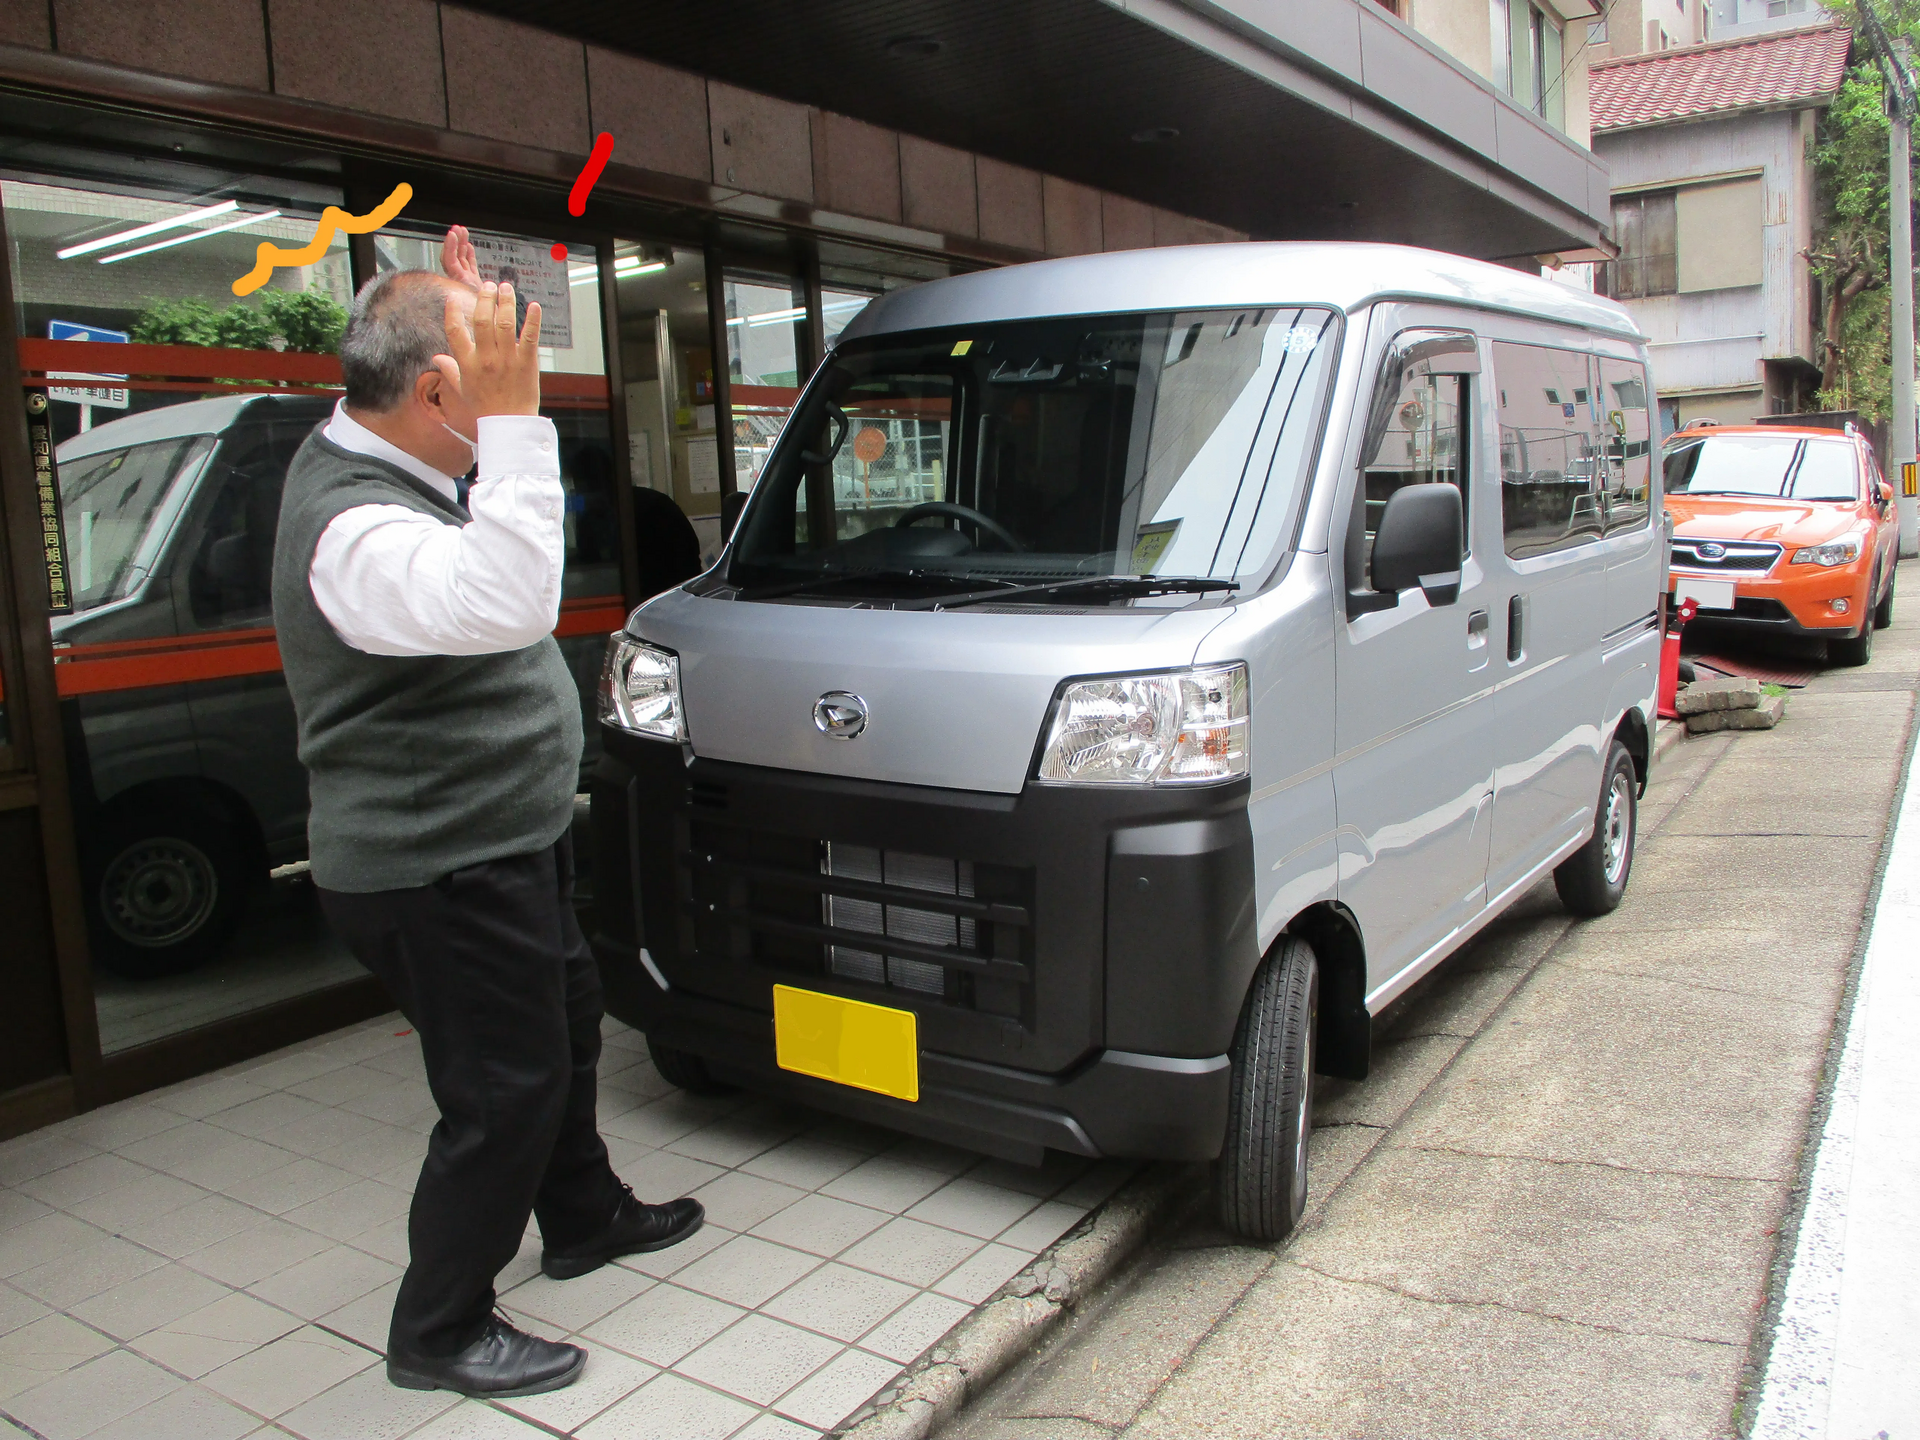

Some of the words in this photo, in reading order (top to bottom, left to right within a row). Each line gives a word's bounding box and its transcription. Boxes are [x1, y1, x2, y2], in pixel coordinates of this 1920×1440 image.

[32, 425, 67, 608] 愛知県警備業協同組合員証
